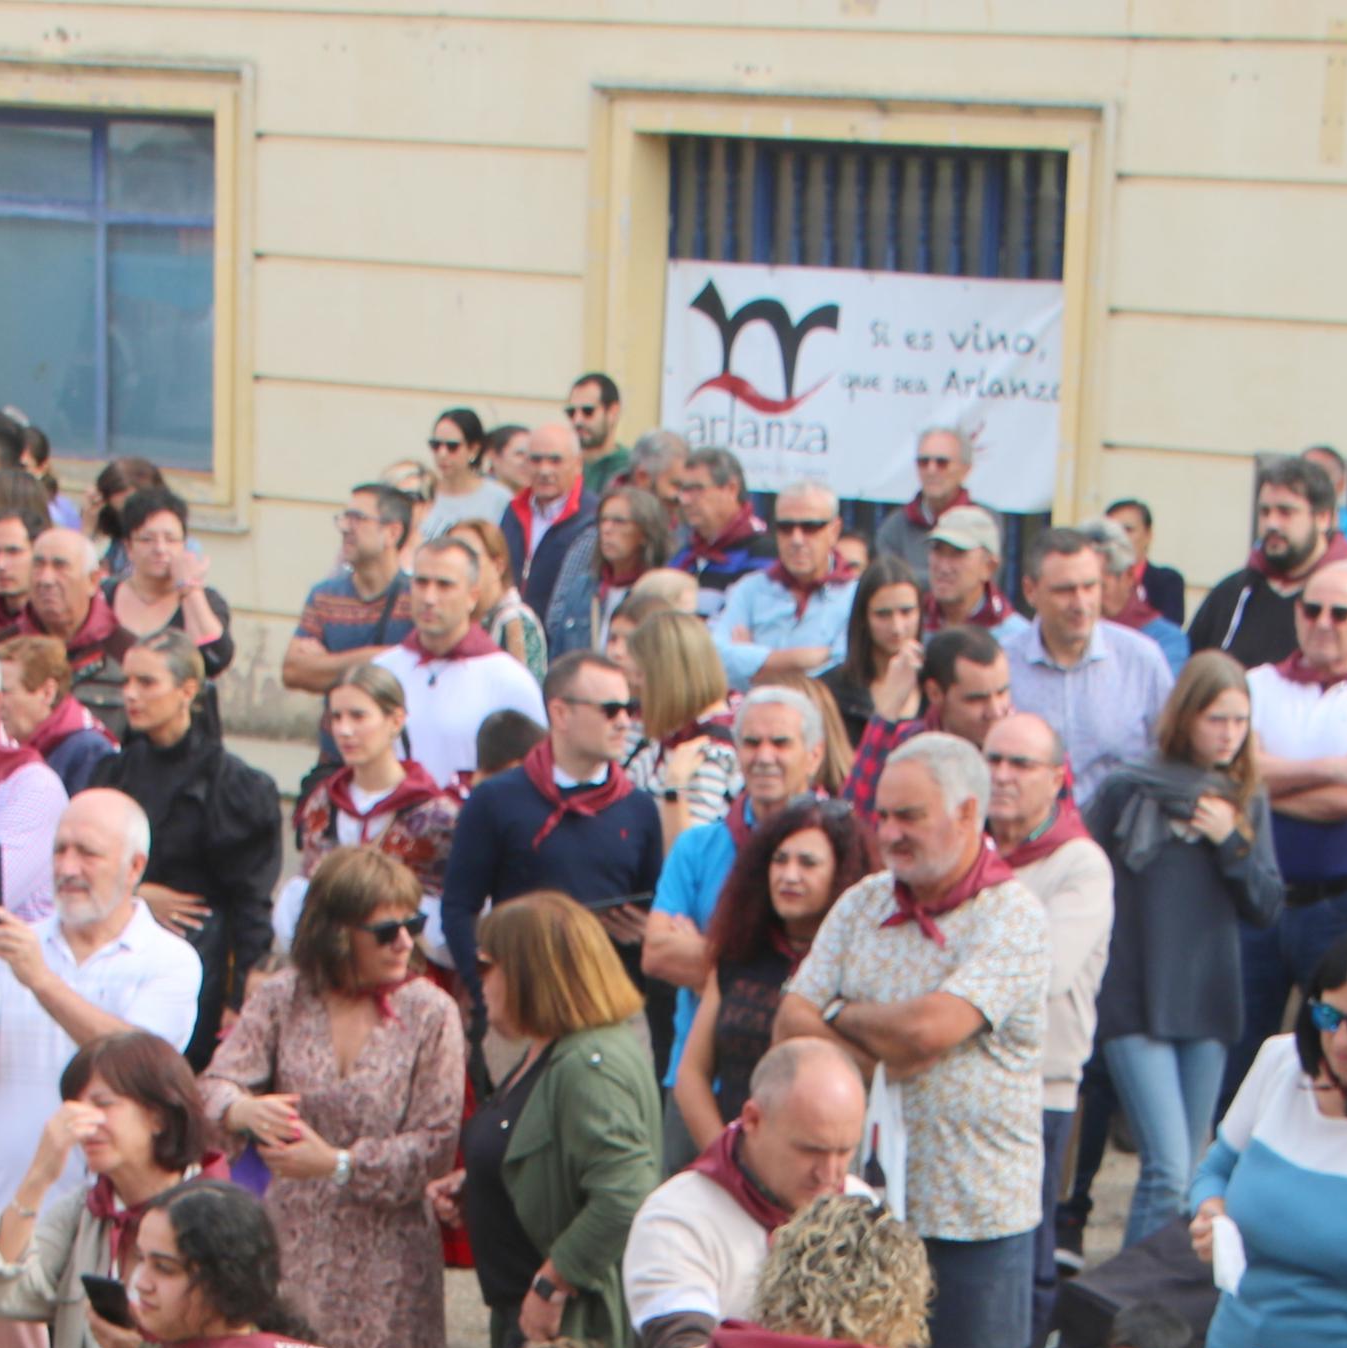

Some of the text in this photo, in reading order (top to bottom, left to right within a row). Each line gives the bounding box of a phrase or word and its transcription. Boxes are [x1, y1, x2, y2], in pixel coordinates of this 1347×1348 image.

[870, 319, 1047, 362] Si es vino,
[842, 373, 881, 402] que
[685, 391, 830, 454] arlanza
